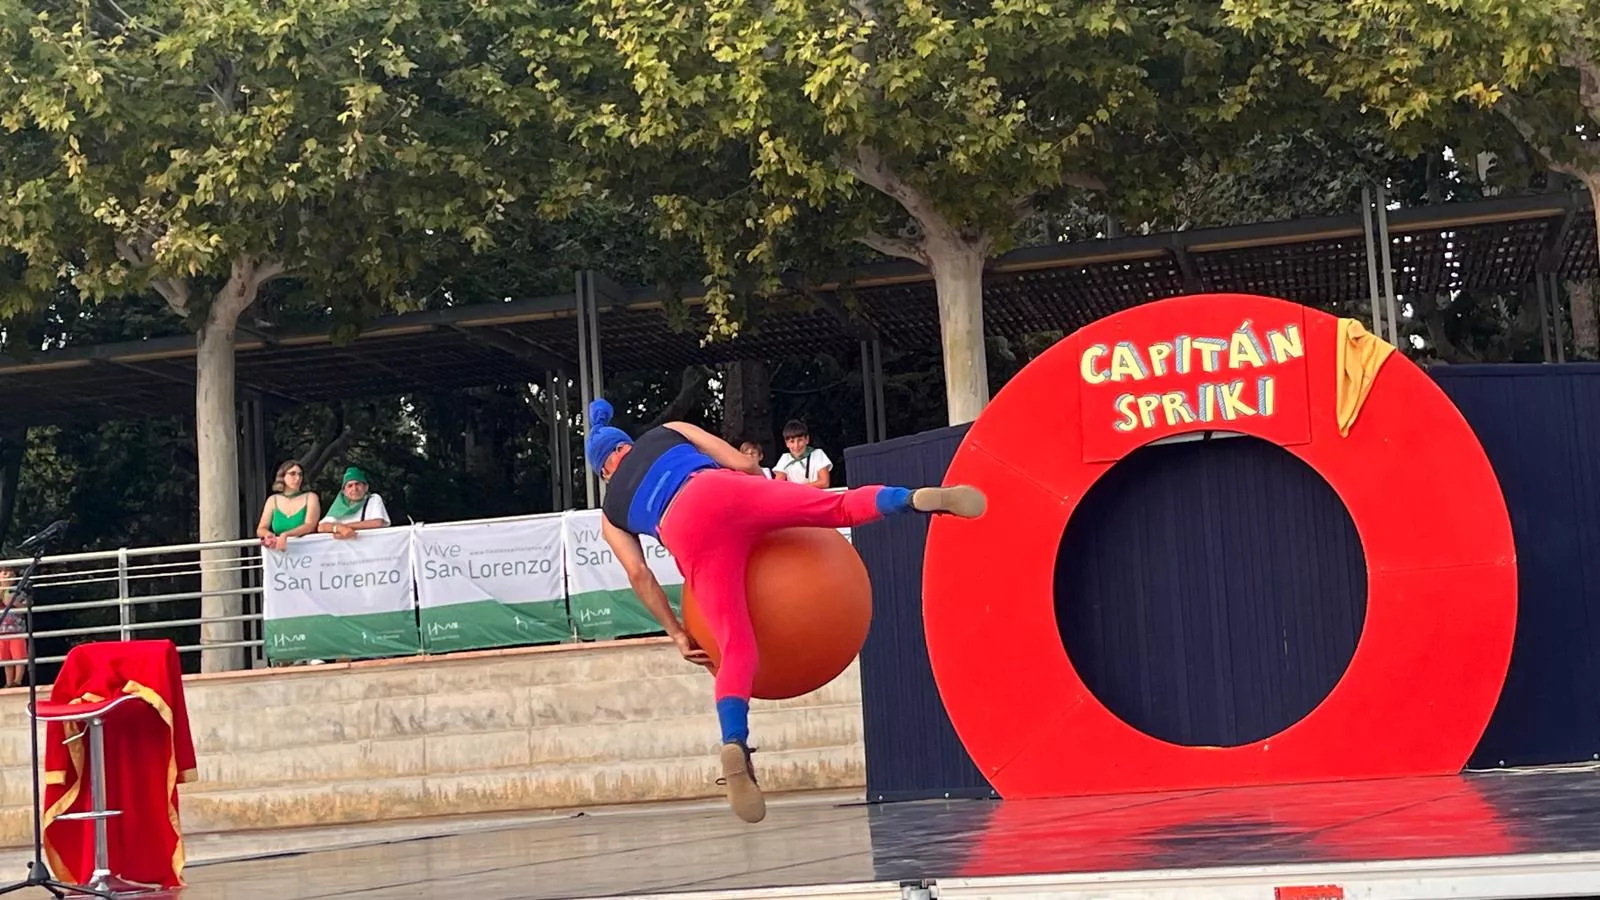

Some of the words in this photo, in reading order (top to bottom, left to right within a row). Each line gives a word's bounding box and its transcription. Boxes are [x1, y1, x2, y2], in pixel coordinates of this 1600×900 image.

[1080, 319, 1304, 384] CAPITÁN
[1113, 376, 1275, 432] SPRIKI
[573, 525, 600, 543] viv
[575, 547, 612, 566] San
[274, 572, 312, 591] San
[319, 569, 401, 590] Lorenzo
[424, 560, 462, 580] San
[468, 559, 552, 579] Lorenzo
